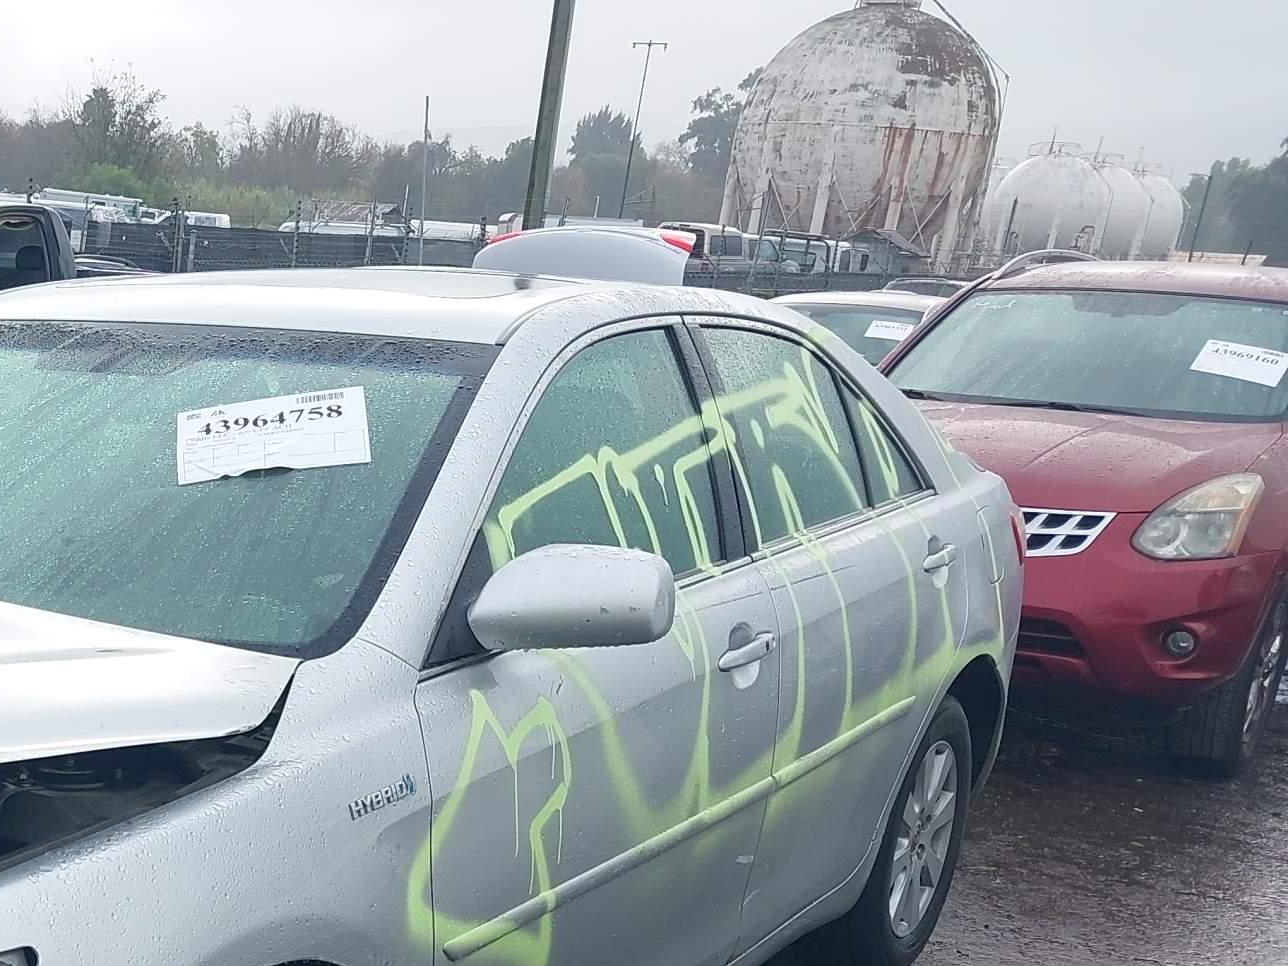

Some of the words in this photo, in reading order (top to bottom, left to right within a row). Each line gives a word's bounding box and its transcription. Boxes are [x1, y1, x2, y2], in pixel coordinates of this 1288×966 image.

[1211, 347, 1280, 366] 43969160
[197, 404, 344, 436] 43964758
[348, 779, 409, 821] HYBRID
